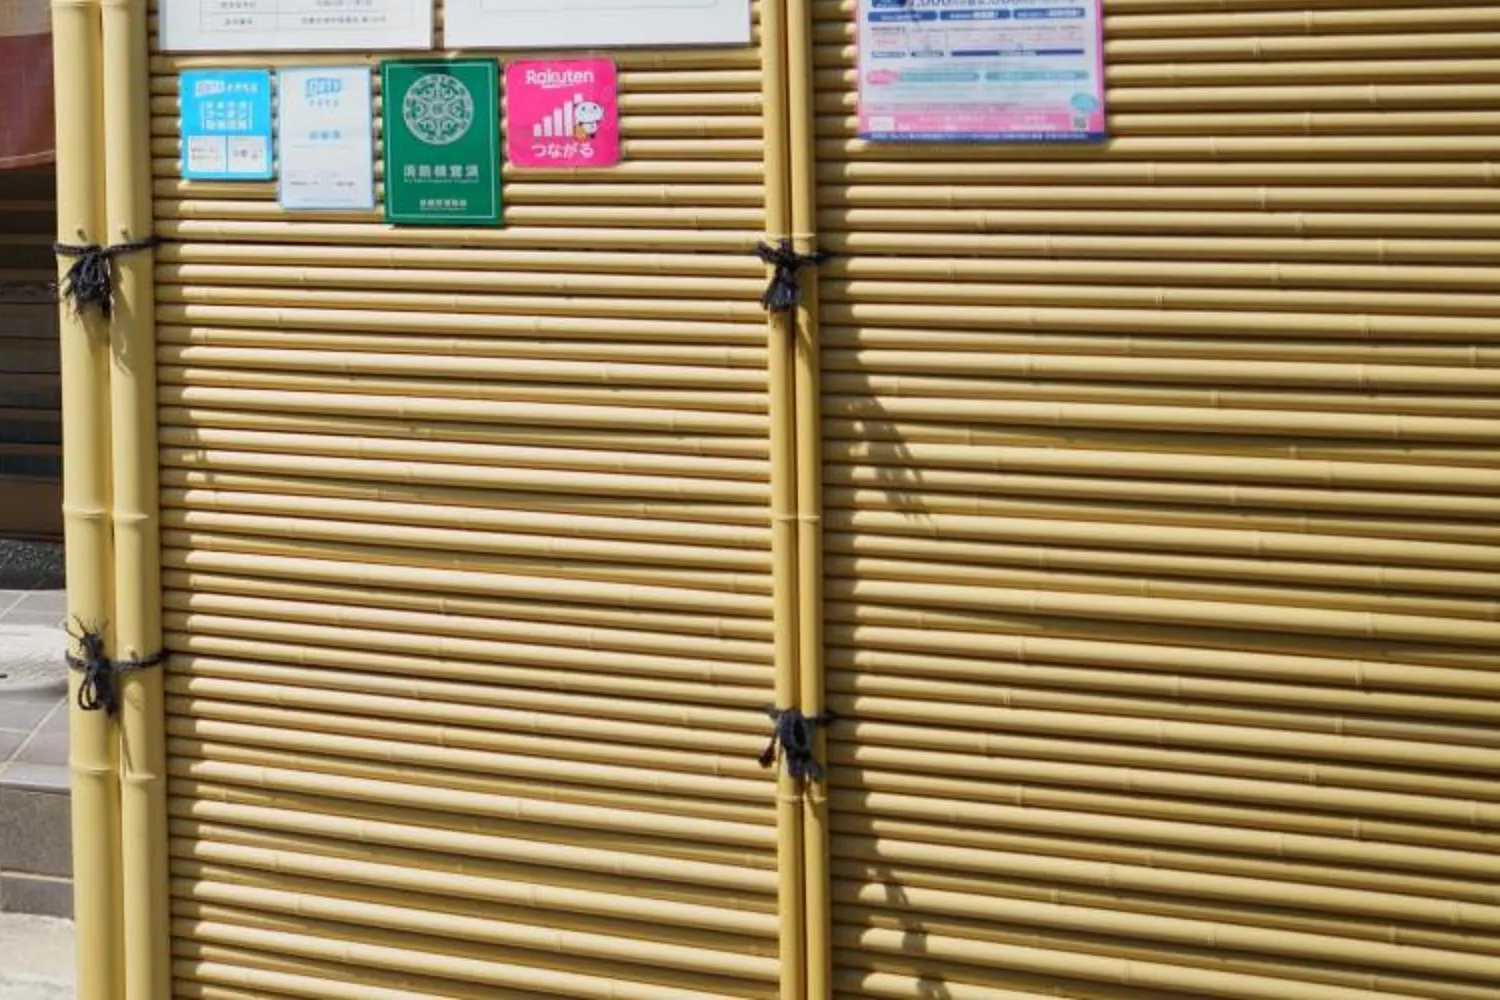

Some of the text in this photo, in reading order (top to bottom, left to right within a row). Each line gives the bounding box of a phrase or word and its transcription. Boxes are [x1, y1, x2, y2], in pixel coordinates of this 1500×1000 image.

[524, 69, 595, 86] Rakuten
[531, 144, 595, 159] つながる
